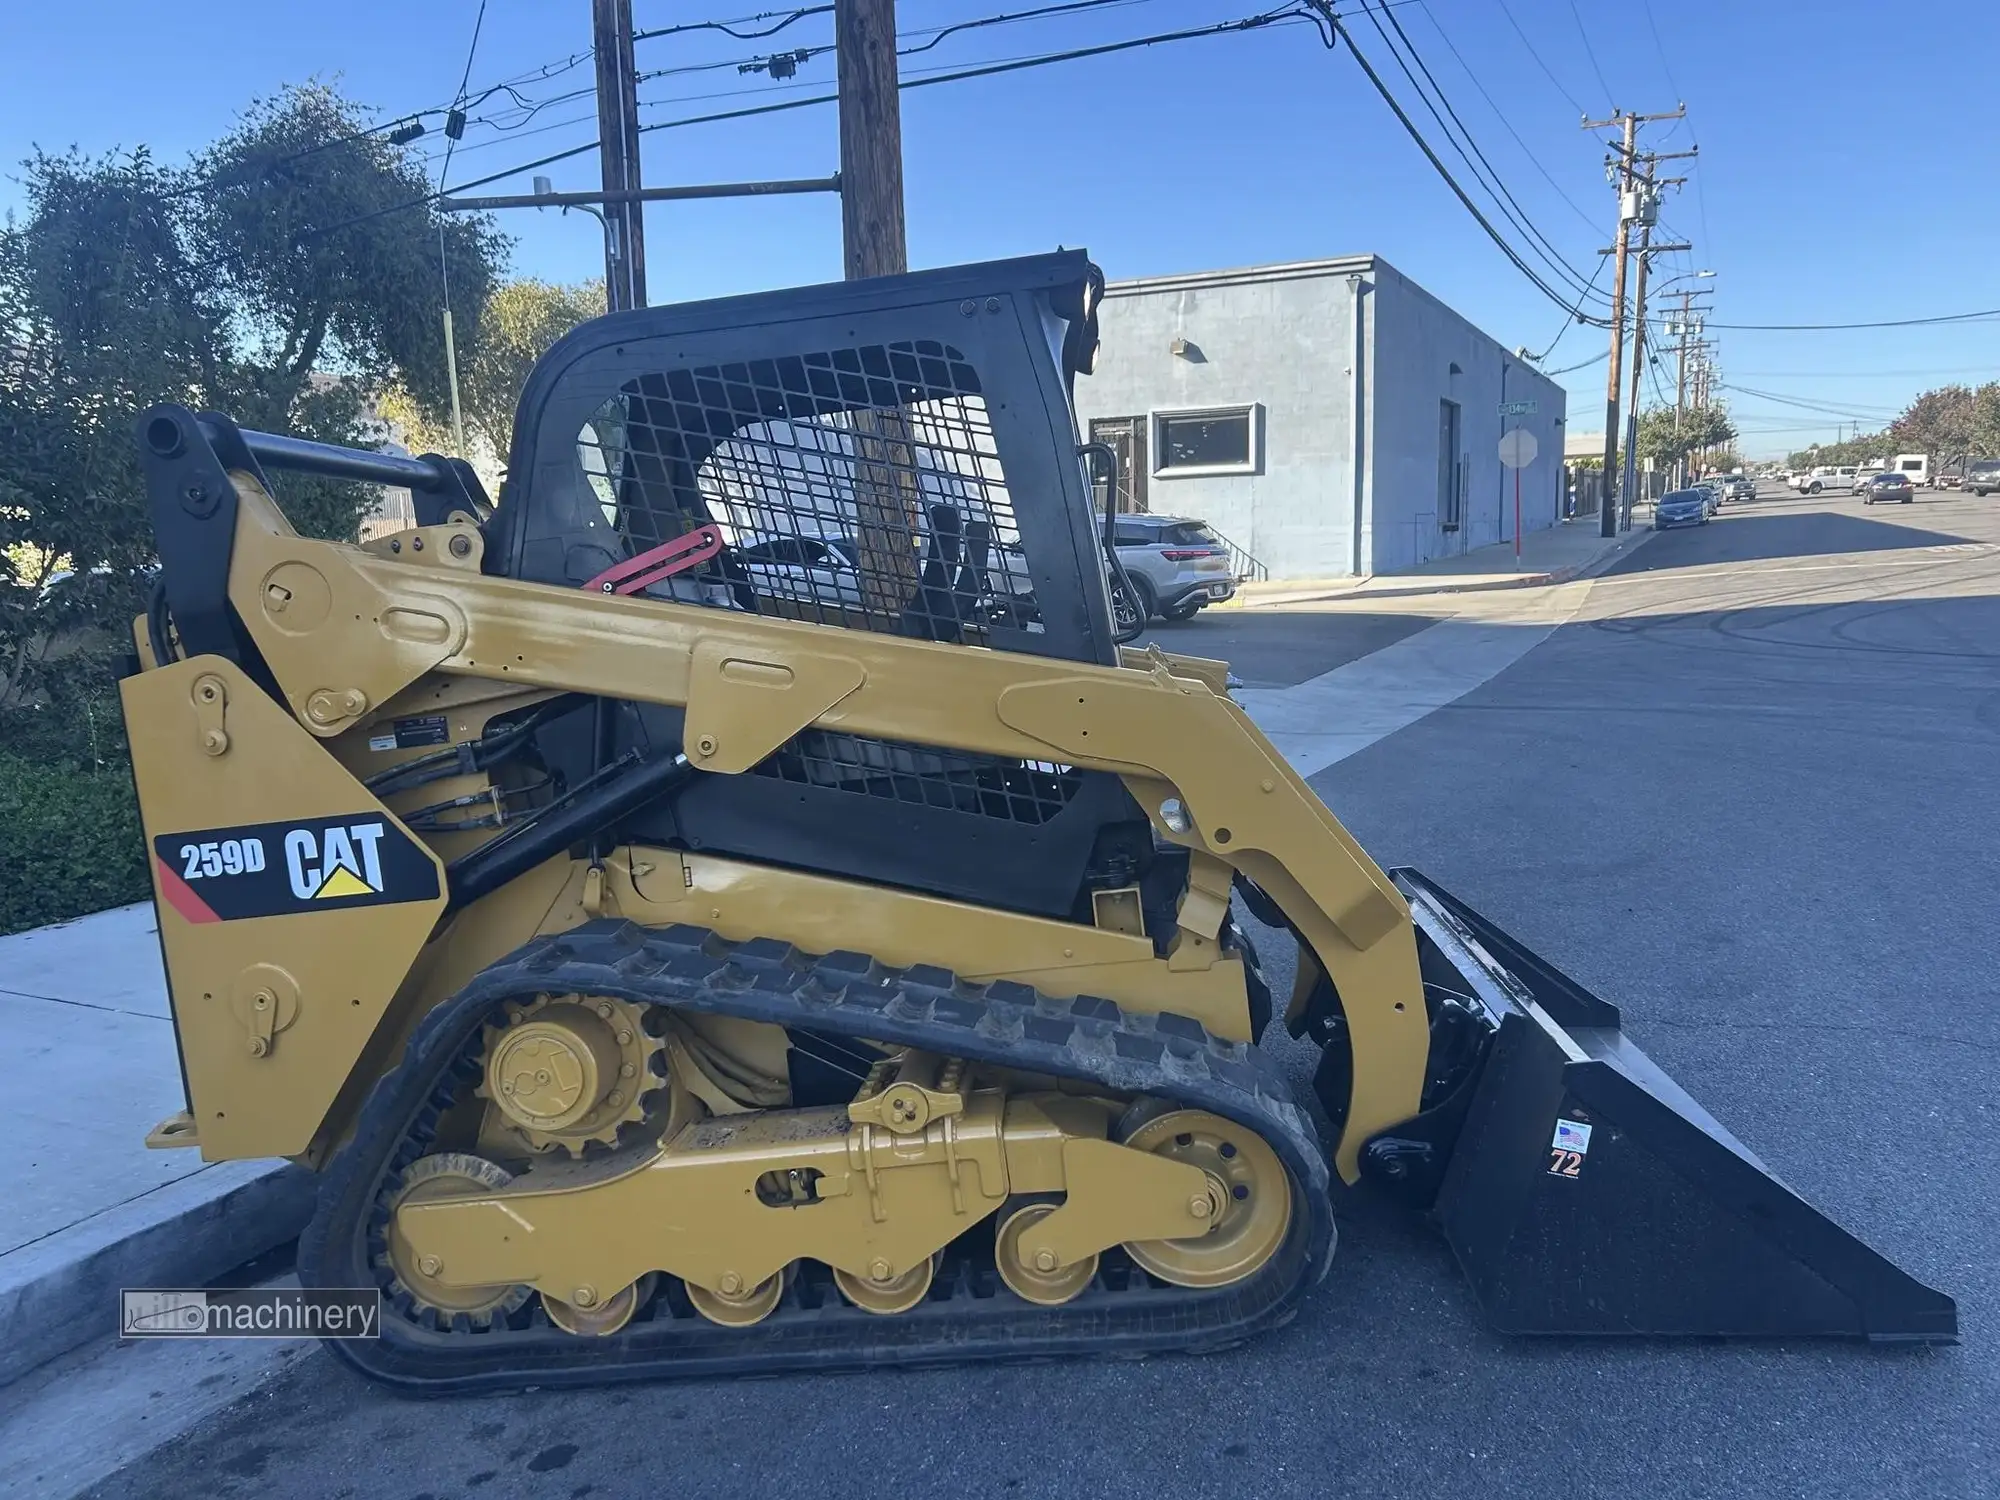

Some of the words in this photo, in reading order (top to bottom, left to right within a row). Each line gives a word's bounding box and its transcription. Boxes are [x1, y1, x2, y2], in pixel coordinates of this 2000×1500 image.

[180, 838, 266, 880] 259D
[284, 823, 384, 899] CAT
[1551, 1149, 1581, 1176] 72
